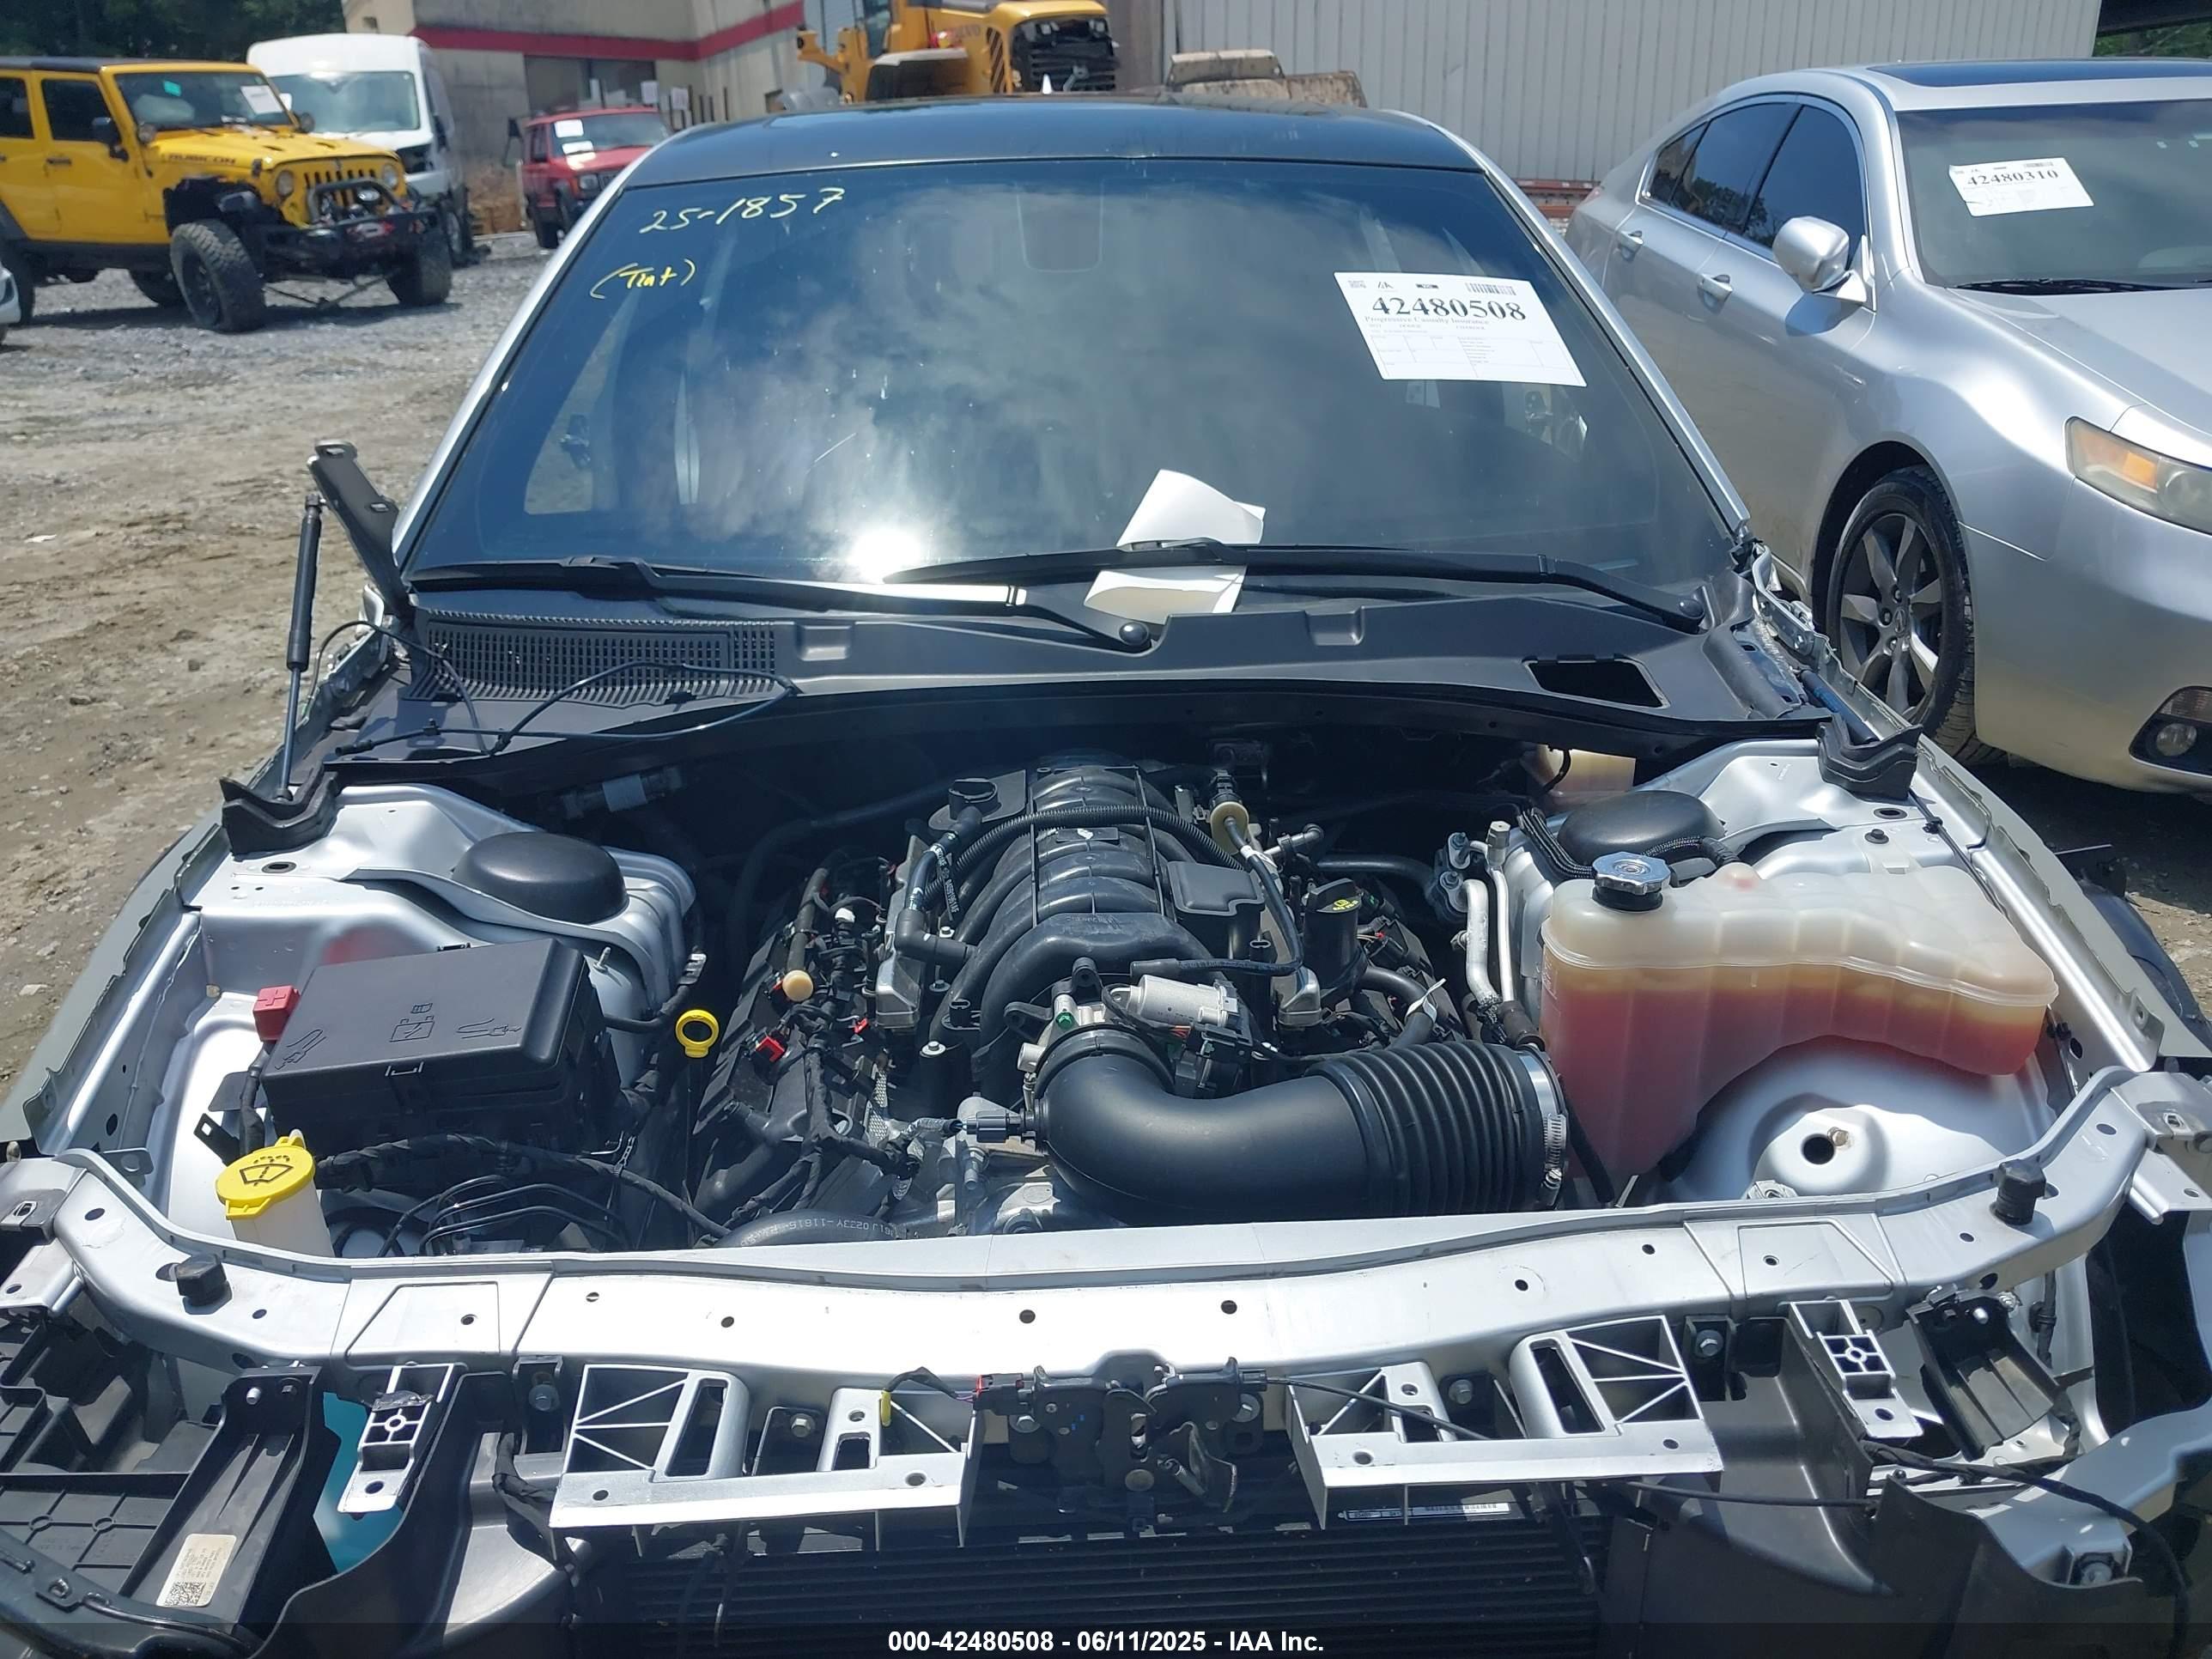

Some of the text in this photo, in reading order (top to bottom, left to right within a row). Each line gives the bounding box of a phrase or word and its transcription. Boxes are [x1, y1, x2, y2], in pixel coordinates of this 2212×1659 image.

[1968, 170, 2058, 185] 42480310
[639, 187, 845, 234] 25-1857
[1372, 297, 1526, 320] 42480508
